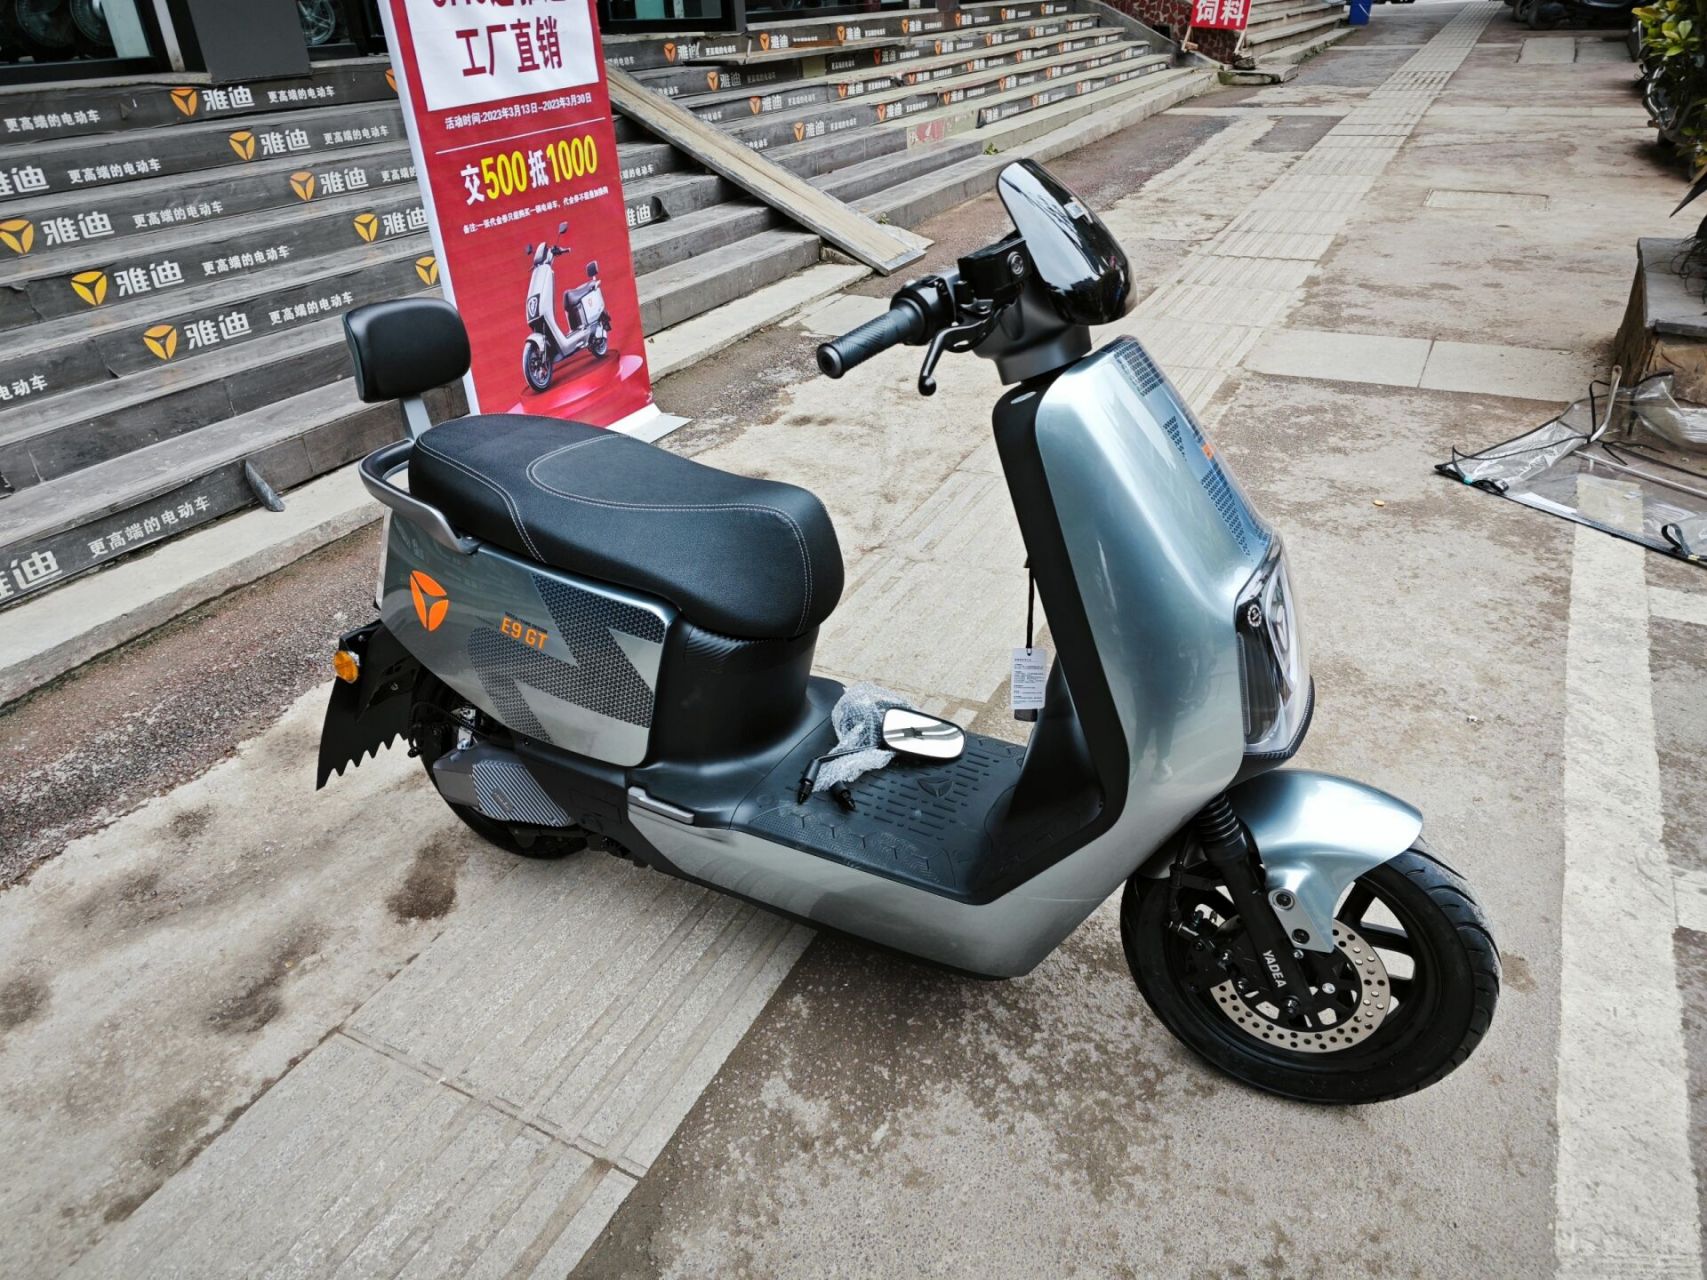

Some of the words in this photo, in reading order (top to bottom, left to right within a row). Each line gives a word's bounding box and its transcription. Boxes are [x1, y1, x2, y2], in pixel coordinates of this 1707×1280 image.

[1196, 0, 1244, 26] 饲料
[455, 15, 563, 77] 工厂直销
[202, 85, 255, 112] 雅迪
[267, 85, 335, 103] 更高端的电动车
[4, 109, 101, 133] 更高端的电动车
[260, 128, 311, 156] 雅迪
[323, 125, 390, 146] 更高端的电动车
[67, 158, 162, 185] 更高端的电动车
[319, 167, 369, 195] 雅迪
[460, 135, 598, 206] 交500抵1000
[41, 211, 115, 246] 雅迪
[133, 201, 224, 229] 更高端的电动车
[382, 207, 429, 236] 雅迪
[114, 260, 185, 298] 雅迪
[202, 245, 291, 276] 更高端的电动车
[184, 311, 252, 350] 雅迪
[269, 291, 354, 325] 更高端的电动车
[87, 495, 211, 559] 更高端的电动车
[501, 616, 522, 640] E9
[526, 628, 549, 650] GT
[1263, 950, 1287, 988] YADEA
